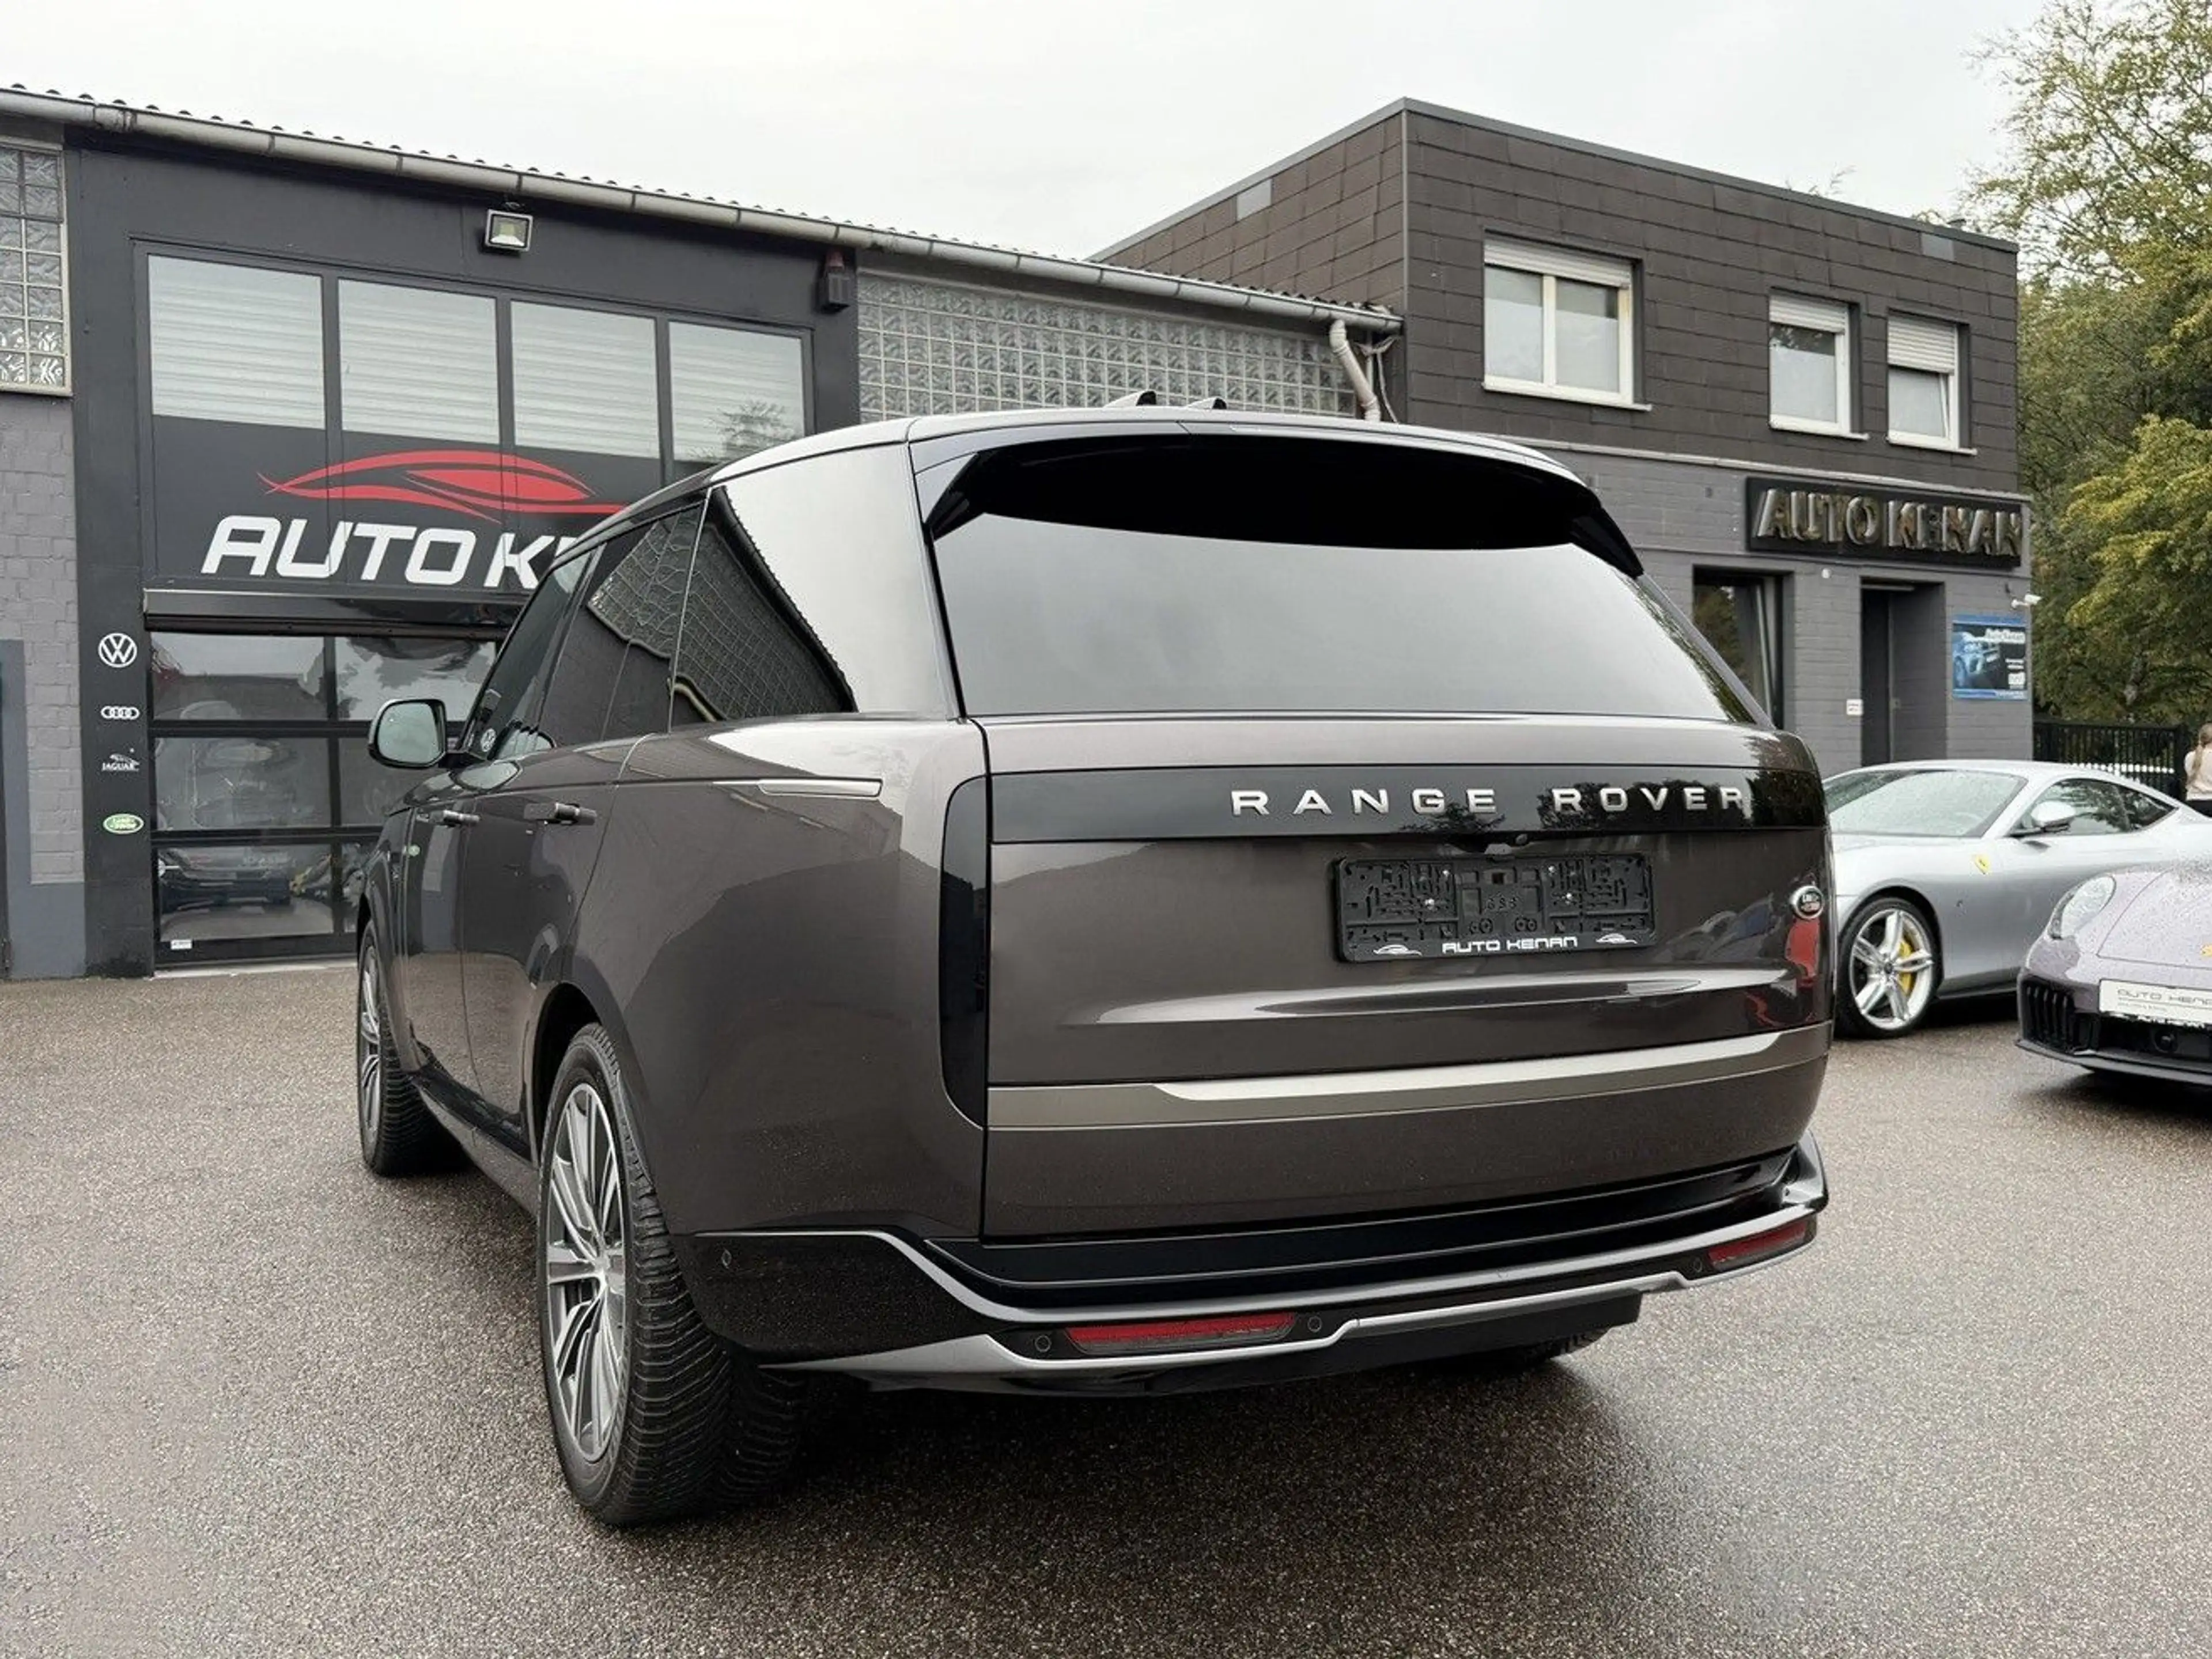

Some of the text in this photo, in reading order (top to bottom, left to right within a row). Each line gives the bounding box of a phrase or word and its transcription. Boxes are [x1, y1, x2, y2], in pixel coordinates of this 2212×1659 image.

[1753, 488, 2021, 556] AUTO KENAN
[201, 515, 476, 586] AUTO
[1231, 787, 1753, 819] RANGE ROVER
[1442, 936, 1578, 954] AUTO KENAN
[2118, 988, 2161, 1000] AUTO
